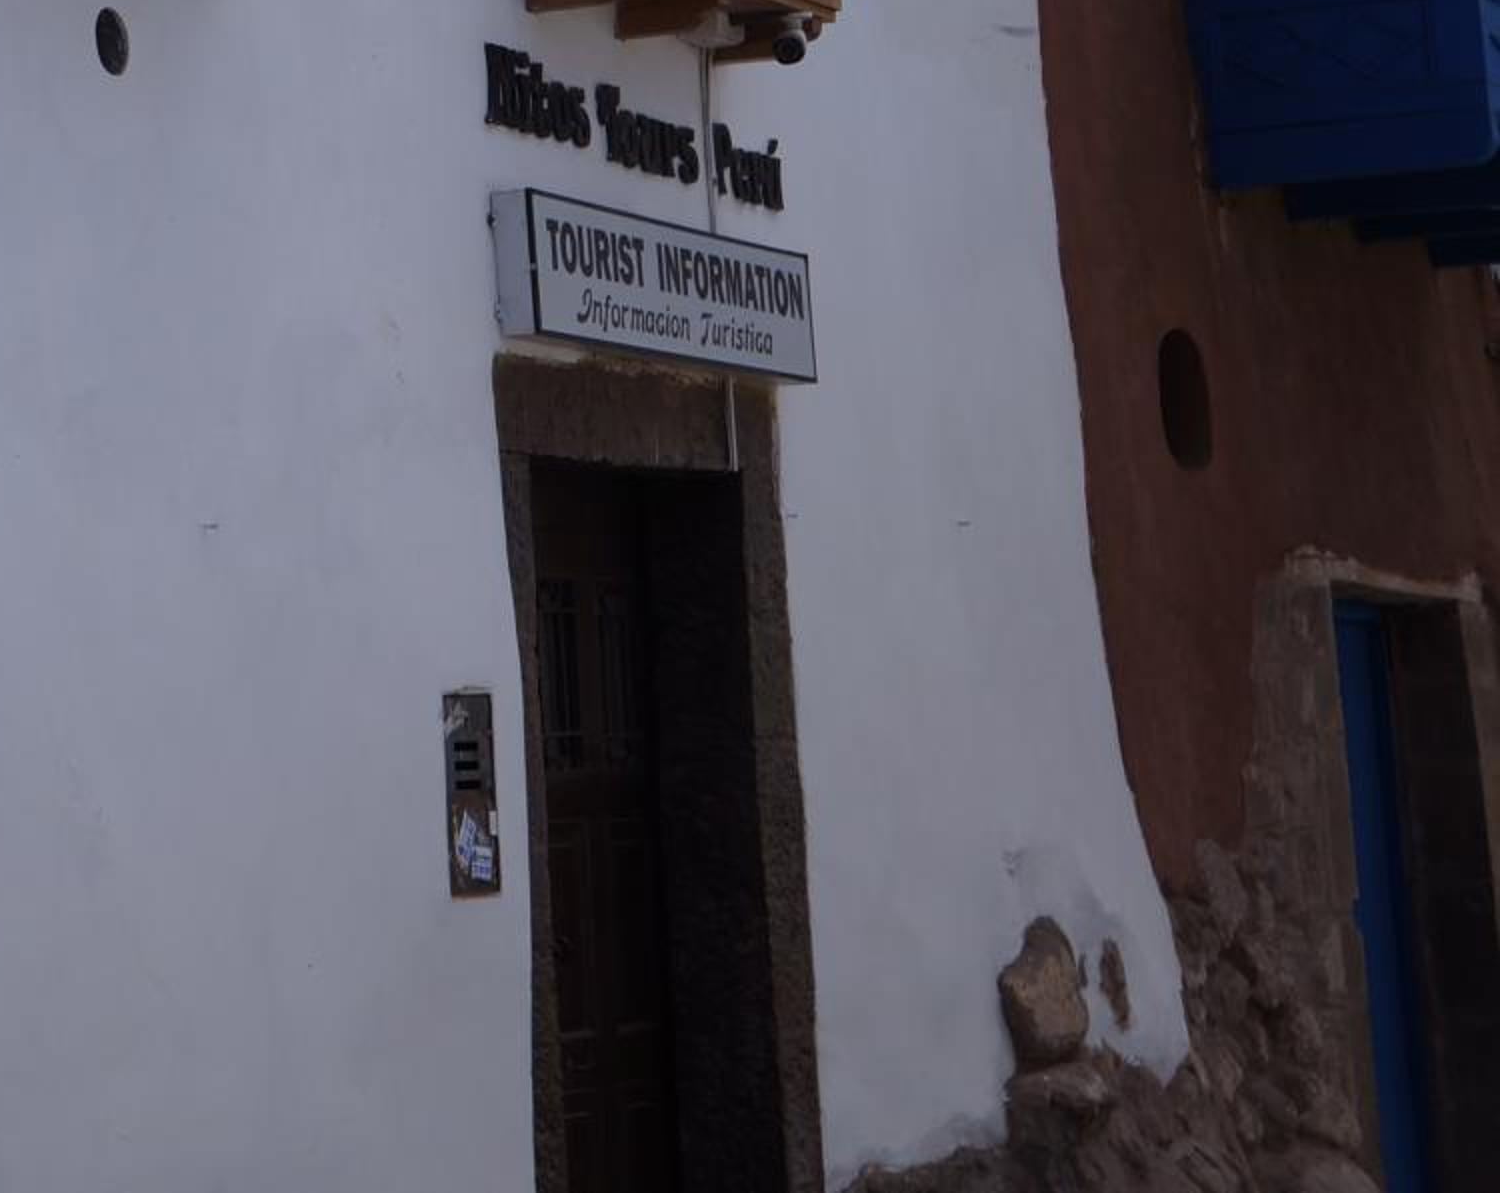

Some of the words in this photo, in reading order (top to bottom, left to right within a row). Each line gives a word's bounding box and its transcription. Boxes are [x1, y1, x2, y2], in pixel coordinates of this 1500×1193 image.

[595, 84, 699, 184] Tours
[546, 219, 645, 287] TOURIST
[656, 243, 805, 320] INFORMATION
